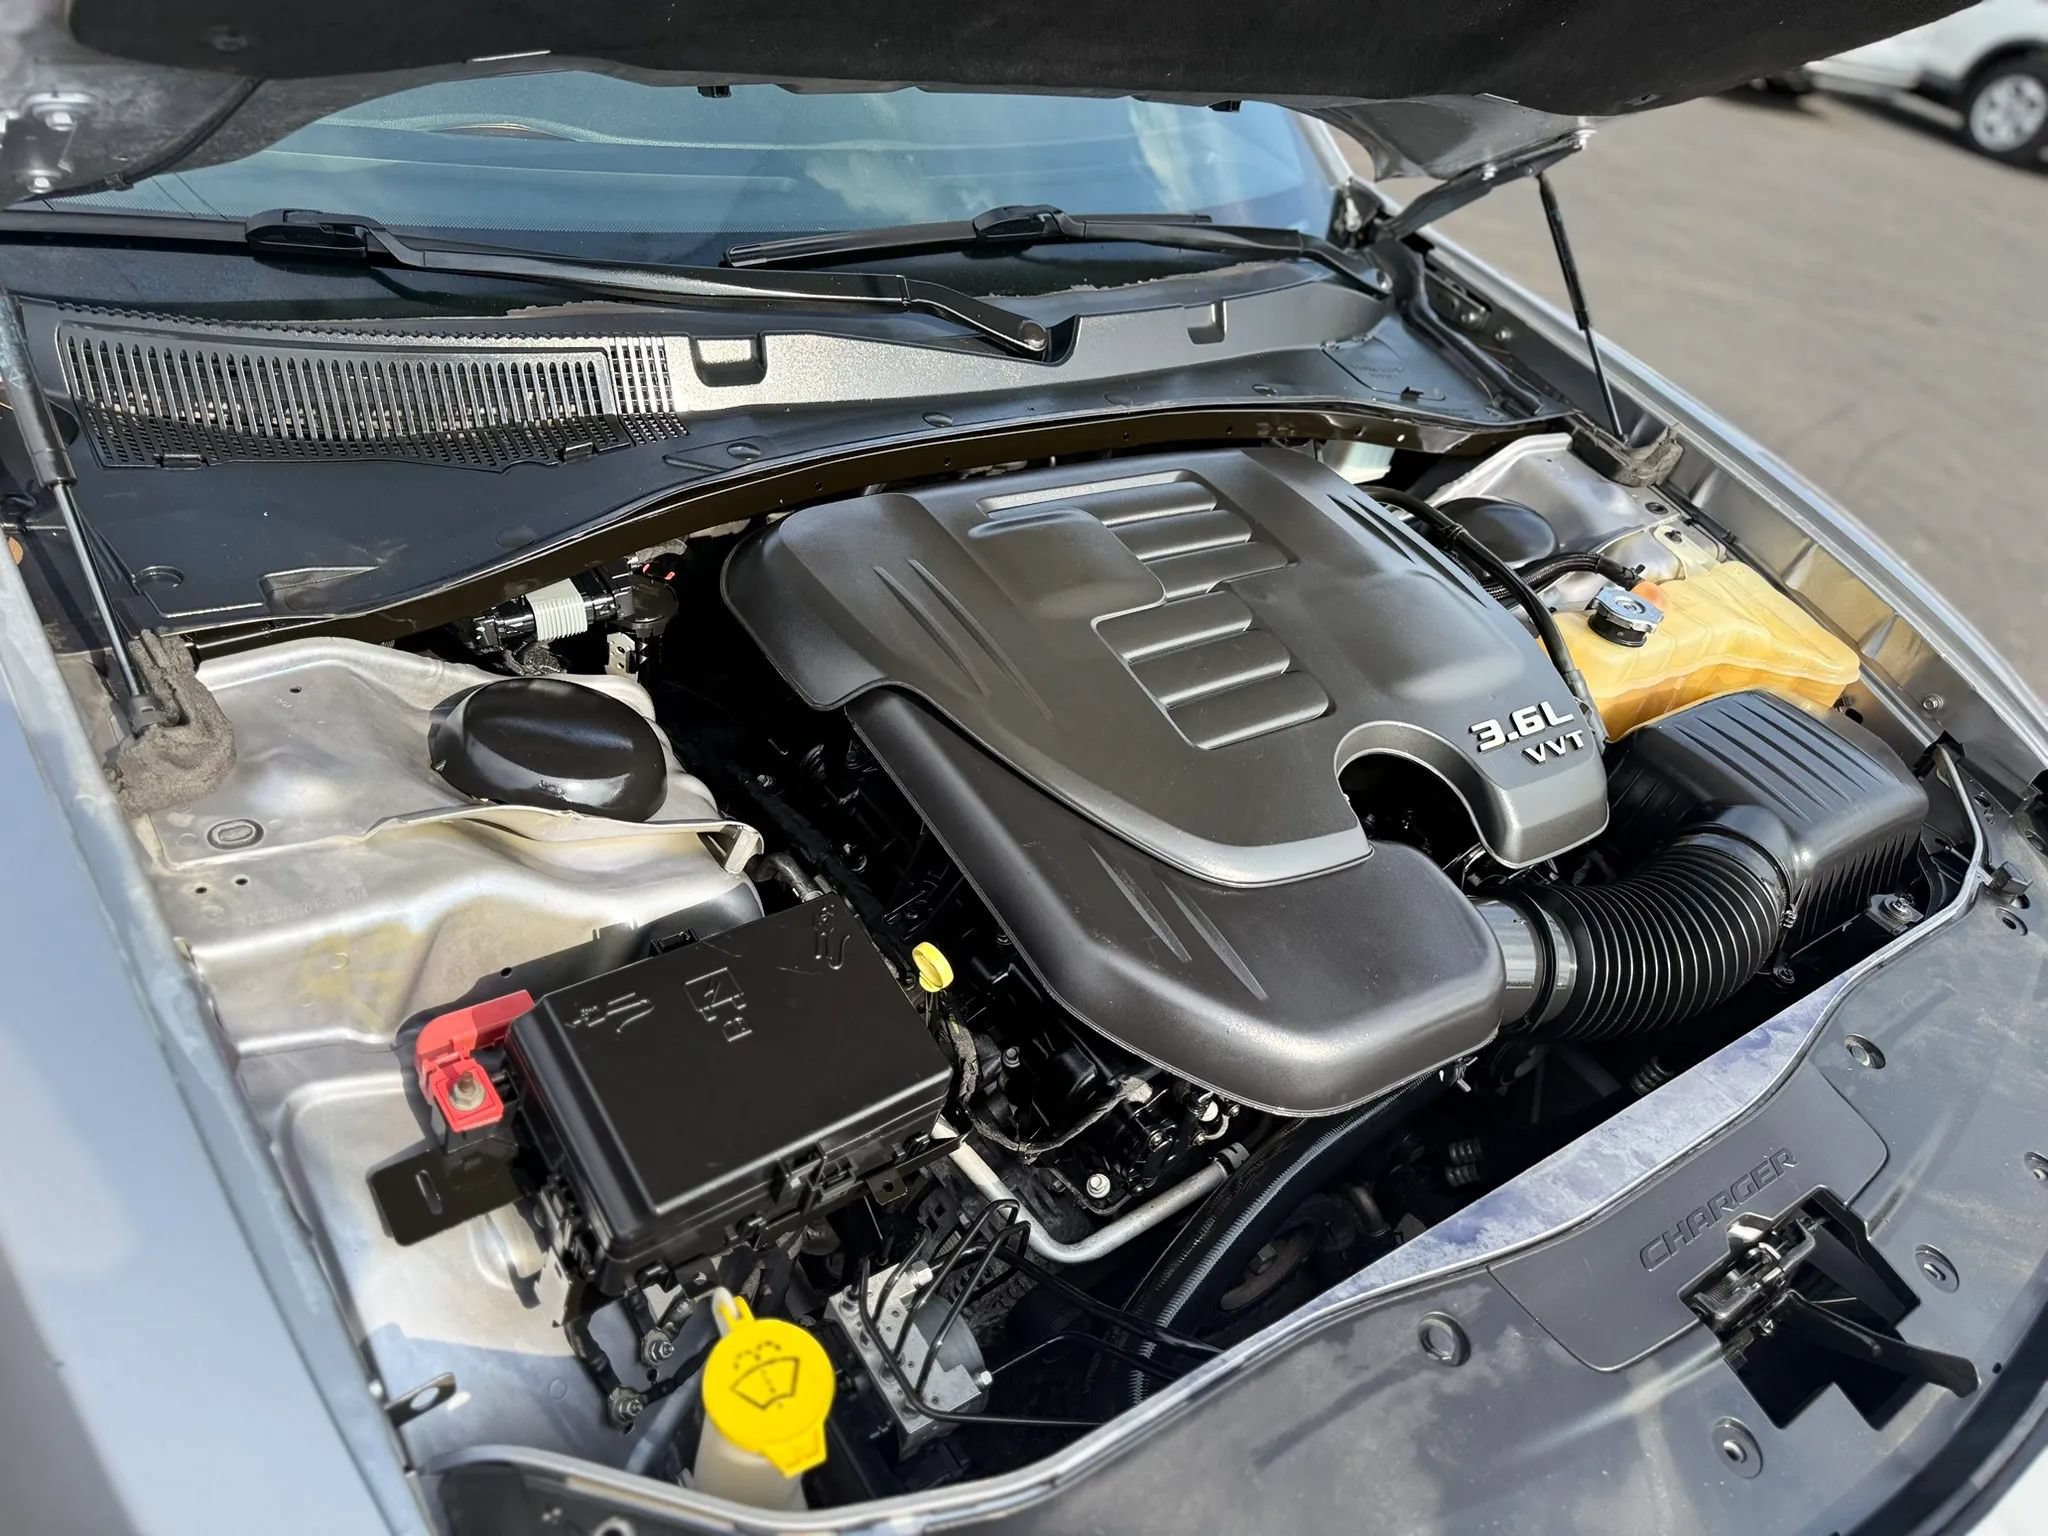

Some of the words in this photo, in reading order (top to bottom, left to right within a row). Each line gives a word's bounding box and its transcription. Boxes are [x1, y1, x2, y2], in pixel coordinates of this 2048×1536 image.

[1469, 701, 1575, 753] 3.6L
[1522, 729, 1584, 765] VVT
[1639, 1147, 1799, 1272] CHARGER
